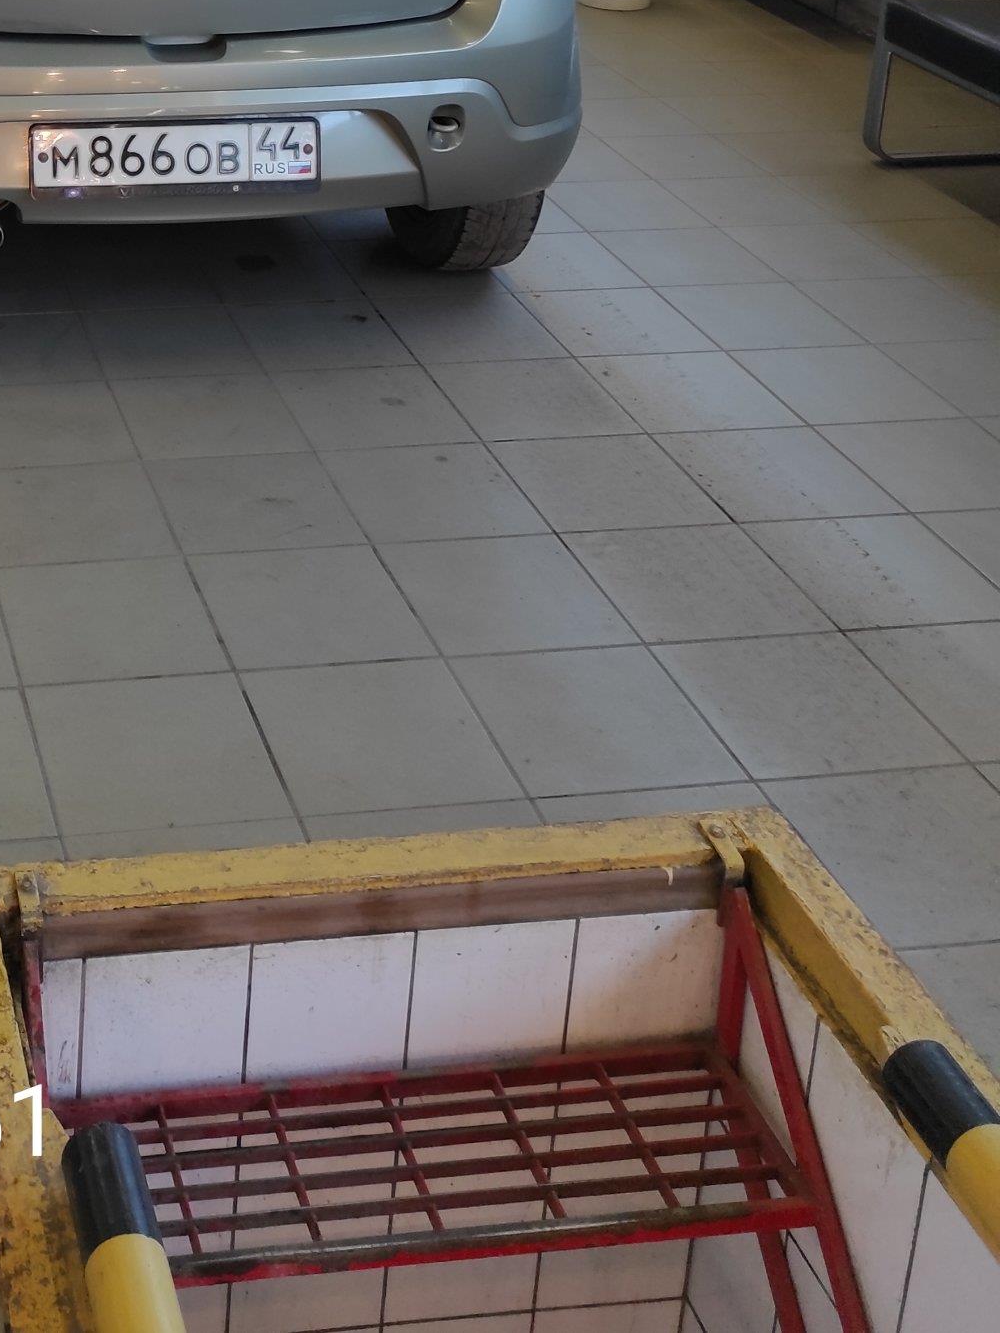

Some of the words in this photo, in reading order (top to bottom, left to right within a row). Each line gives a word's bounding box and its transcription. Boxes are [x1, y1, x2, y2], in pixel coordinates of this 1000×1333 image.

[52, 132, 240, 179] М866ОВ
[256, 125, 301, 162] 44
[253, 162, 287, 175] RUS
